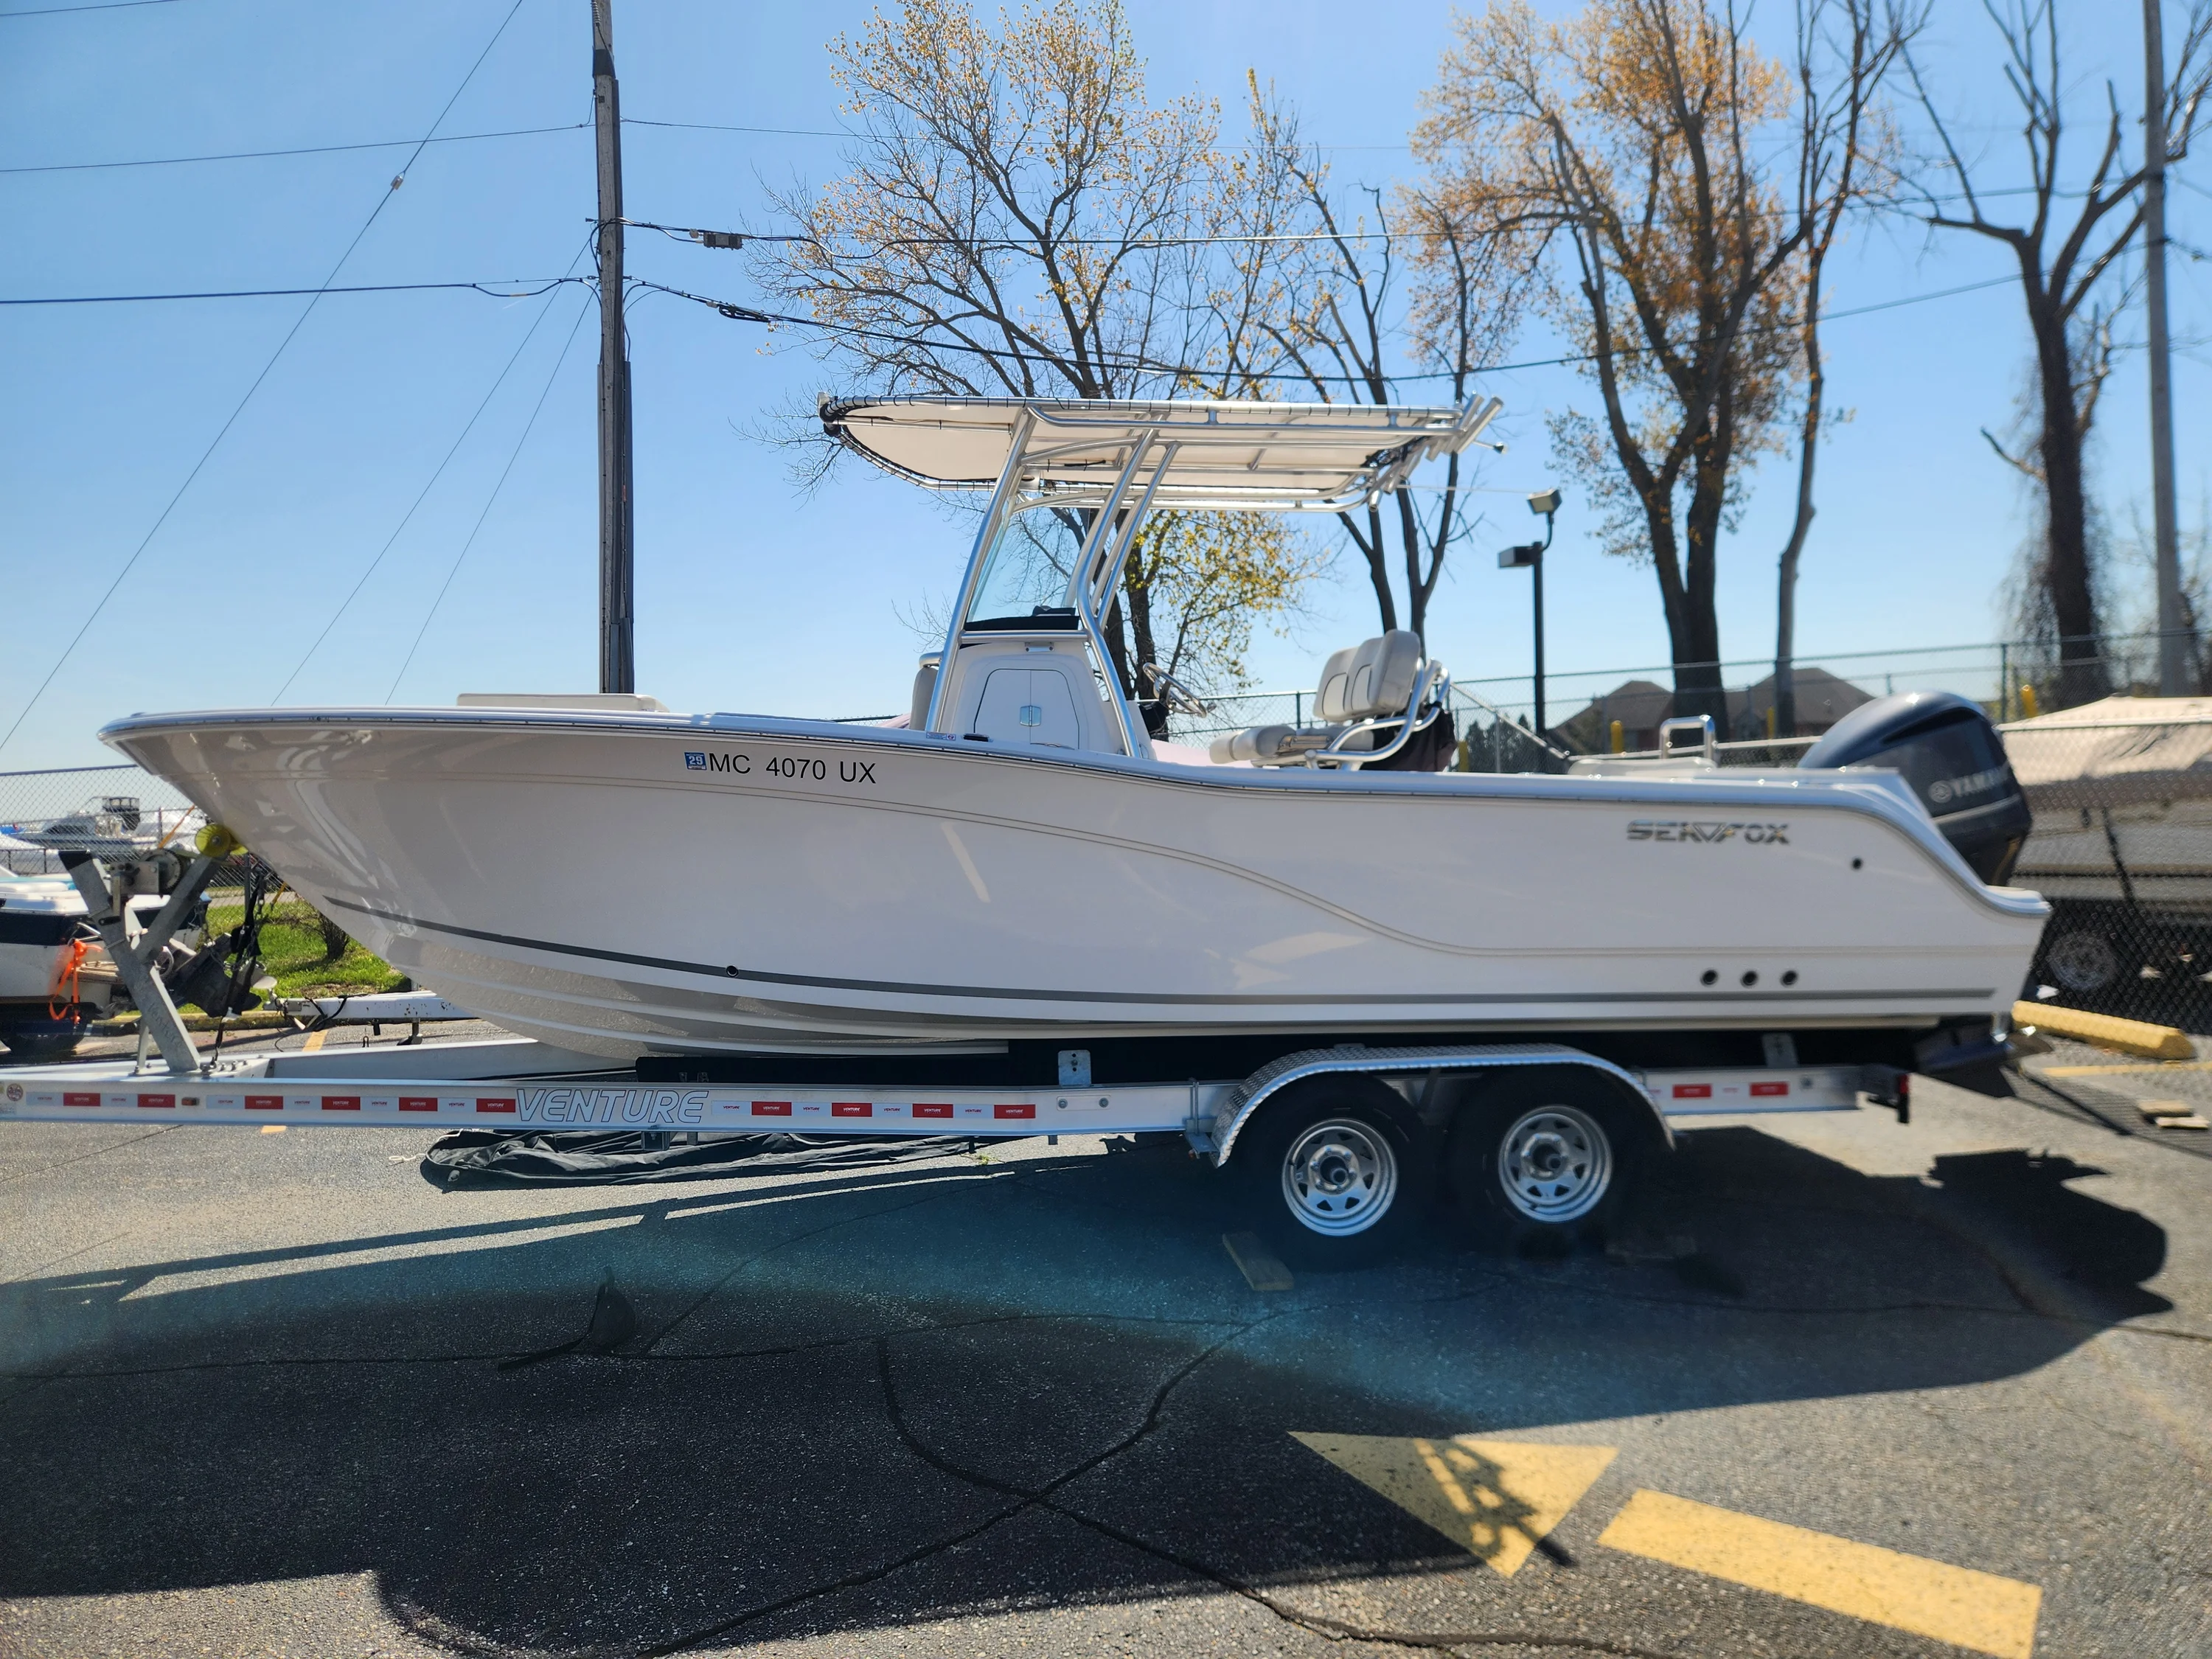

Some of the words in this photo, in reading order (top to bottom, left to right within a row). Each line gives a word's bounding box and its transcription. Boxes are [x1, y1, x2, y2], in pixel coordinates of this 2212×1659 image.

[689, 756, 703, 765] 29
[709, 753, 751, 774] MC
[765, 757, 827, 780] 4070
[840, 761, 877, 784] UX
[516, 1088, 709, 1123] VENTURE
